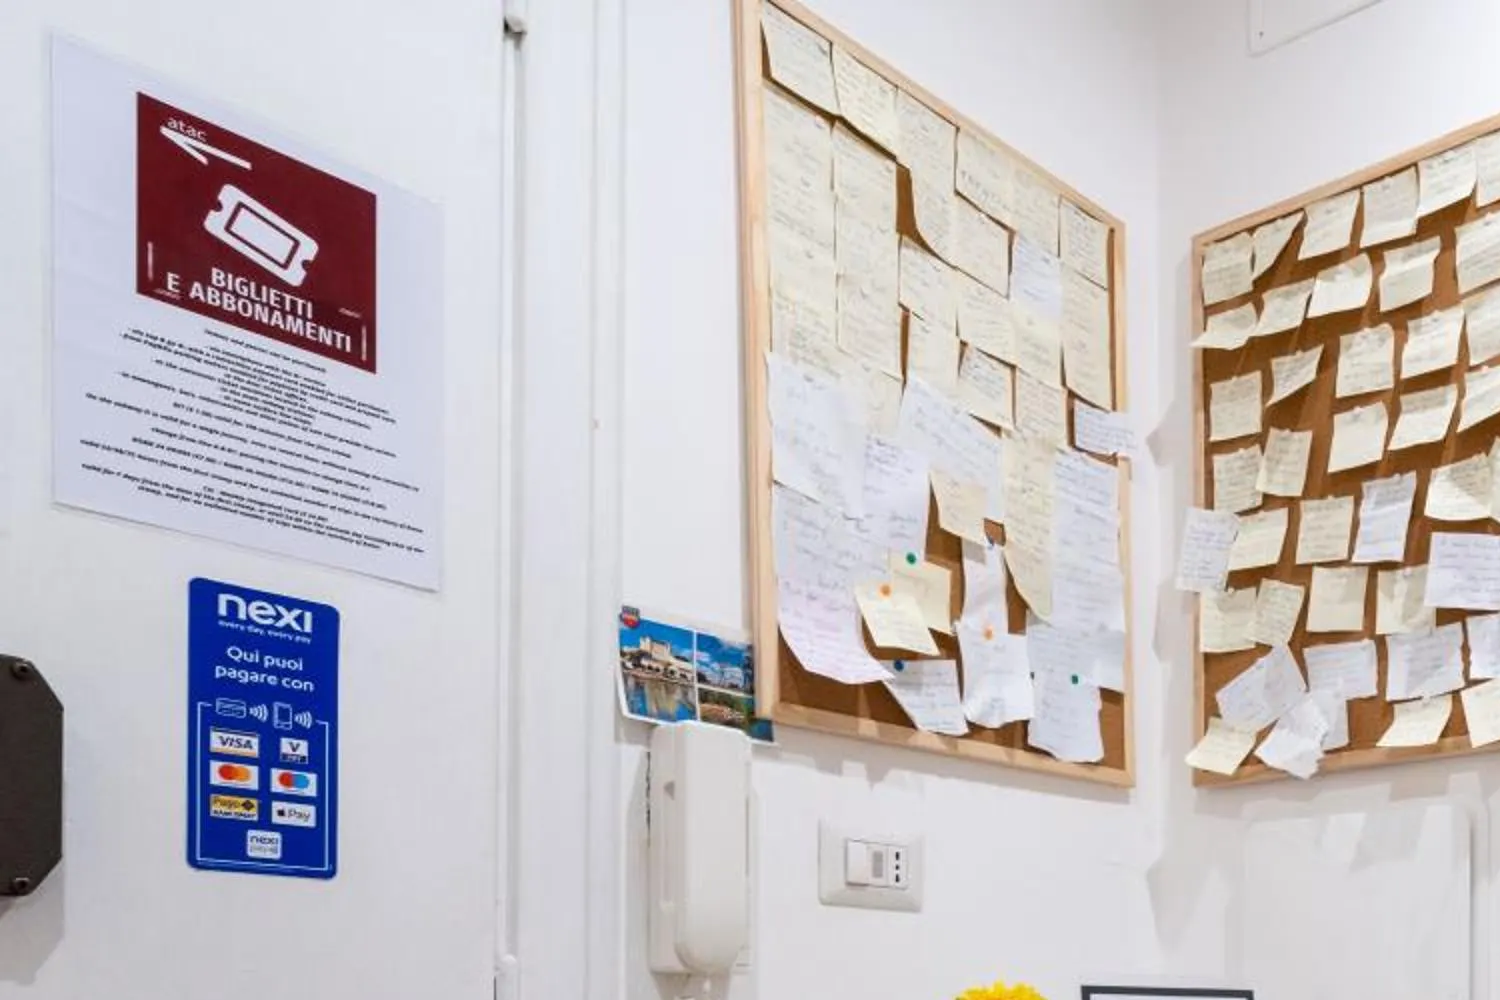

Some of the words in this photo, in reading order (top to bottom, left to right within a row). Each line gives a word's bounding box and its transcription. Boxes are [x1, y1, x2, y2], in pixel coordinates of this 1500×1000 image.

[167, 116, 207, 142] atac
[211, 267, 313, 319] BIGLIETTI
[166, 271, 181, 293] E
[189, 282, 351, 353] ABBONAMENTI
[217, 593, 313, 633] nexi
[226, 646, 260, 663] Qui
[263, 655, 303, 671] puoi
[214, 665, 278, 685] pagare
[281, 677, 315, 692] con
[217, 735, 253, 750] VISA
[288, 741, 300, 753] V
[287, 807, 311, 822] Pay
[249, 835, 279, 845] nexi
